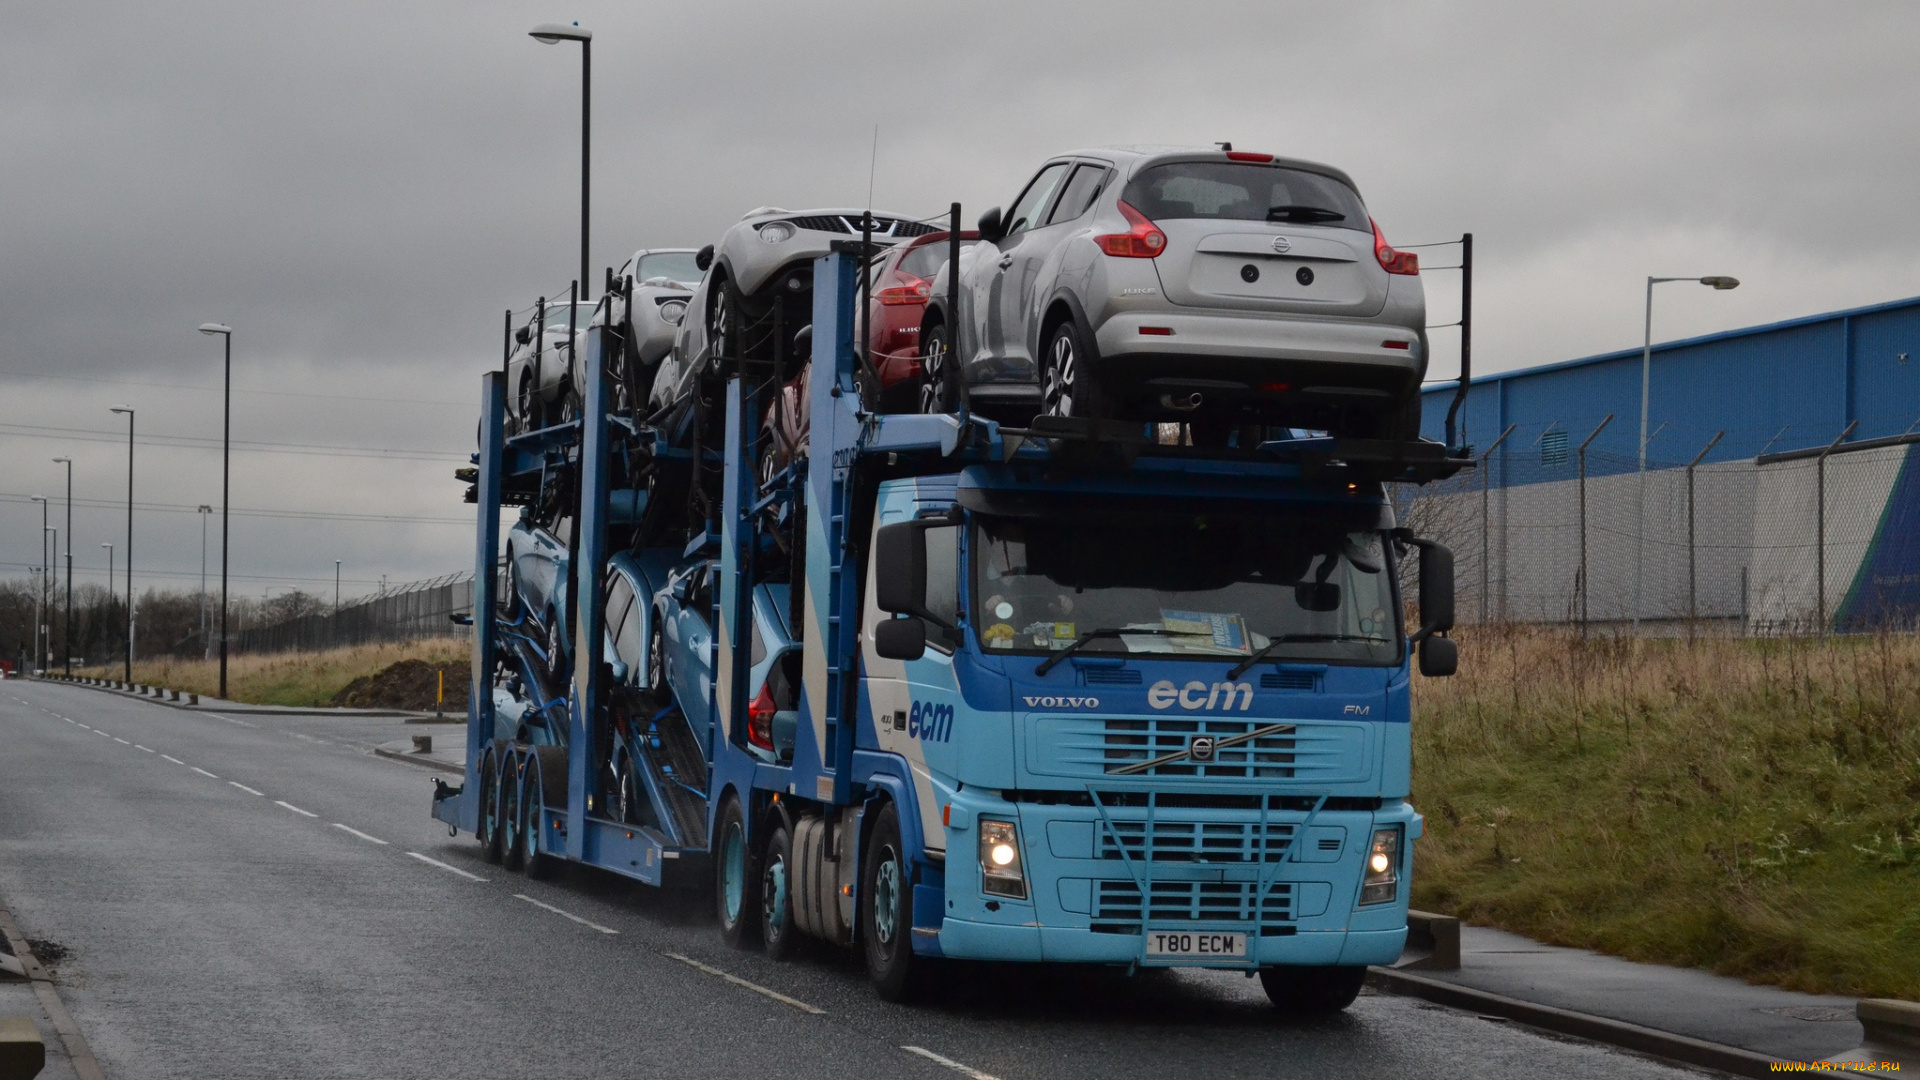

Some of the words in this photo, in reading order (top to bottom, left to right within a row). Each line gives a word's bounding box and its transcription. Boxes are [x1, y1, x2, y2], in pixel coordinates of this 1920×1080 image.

[1121, 287, 1156, 297] JUKE
[1022, 696, 1100, 709] VOLVO
[1147, 680, 1254, 711] ecm
[1343, 704, 1370, 716] FM
[908, 699, 955, 744] ecm
[1155, 934, 1192, 953] T80
[1198, 935, 1235, 953] ECM
